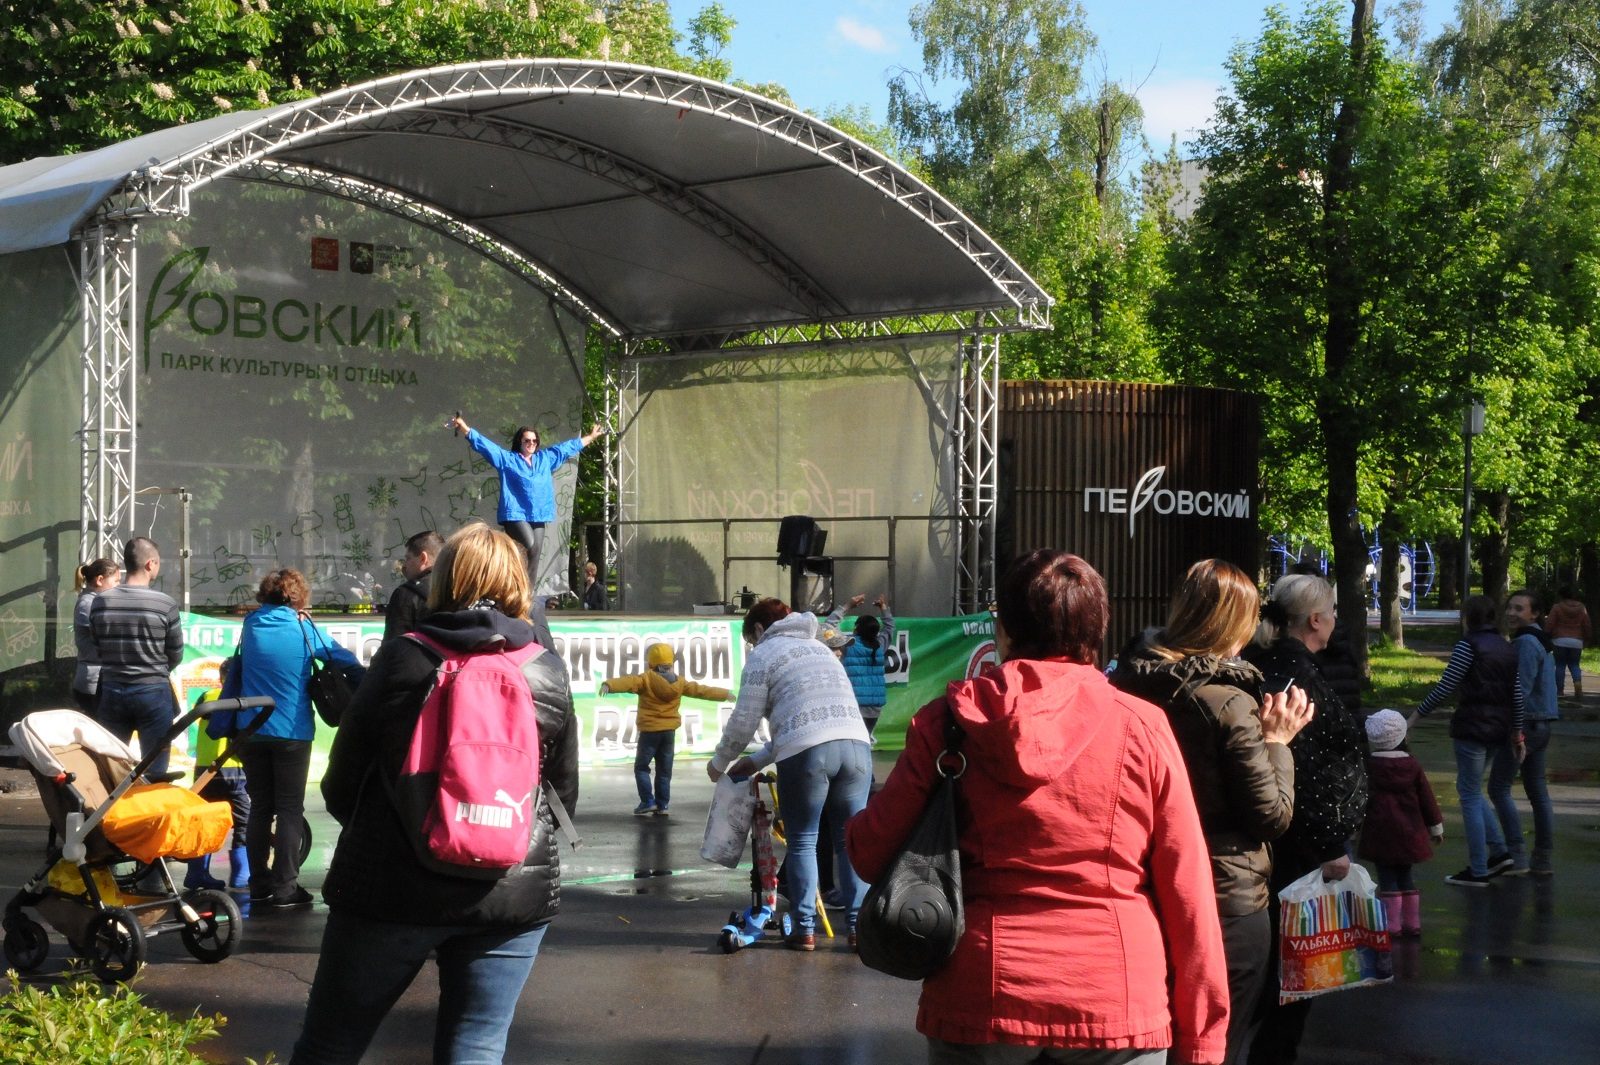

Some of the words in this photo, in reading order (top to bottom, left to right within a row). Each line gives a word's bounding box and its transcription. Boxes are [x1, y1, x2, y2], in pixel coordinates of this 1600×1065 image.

[143, 246, 421, 374] РОВСКИЙ
[161, 352, 214, 372] ПАРК
[220, 357, 320, 380] КУЛЬТУРЫ
[327, 364, 339, 381] И
[344, 366, 419, 386] ОТДЫХА
[1084, 465, 1249, 539] ПЕРОВСКИЙ
[455, 801, 513, 828] PUMA
